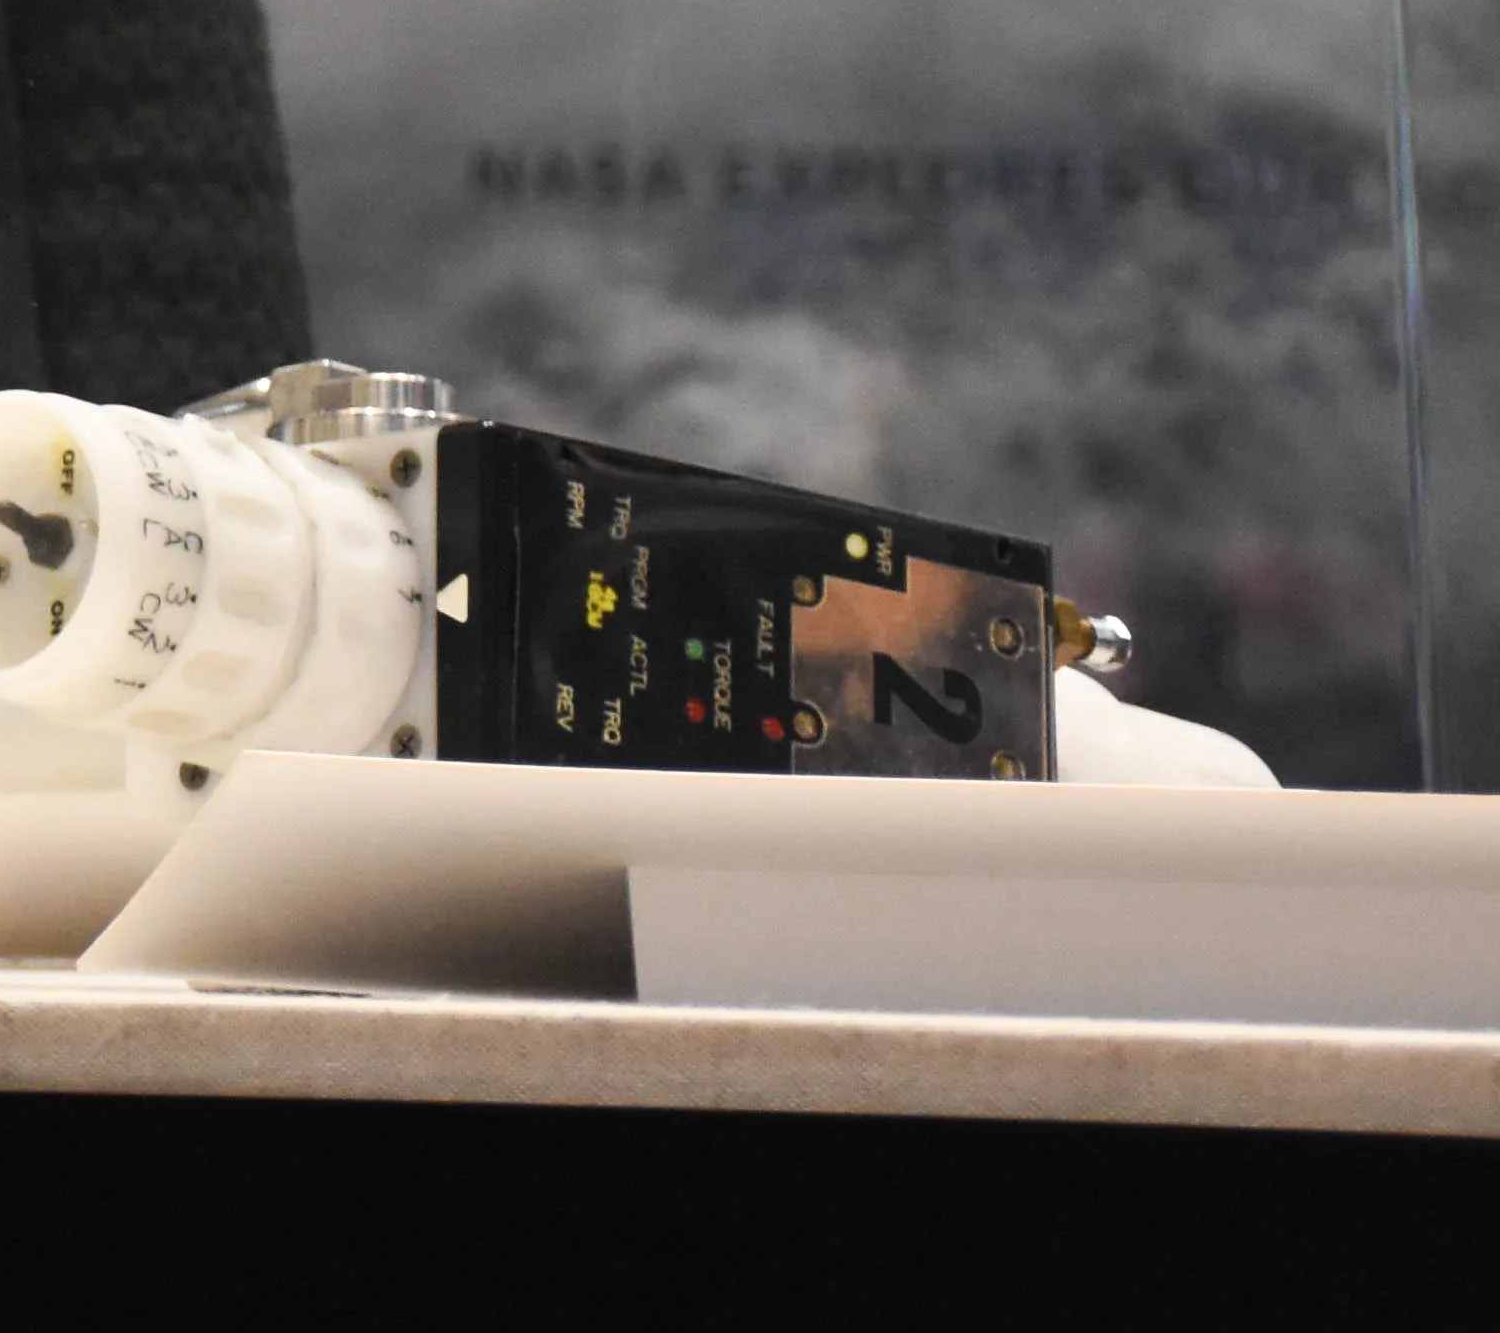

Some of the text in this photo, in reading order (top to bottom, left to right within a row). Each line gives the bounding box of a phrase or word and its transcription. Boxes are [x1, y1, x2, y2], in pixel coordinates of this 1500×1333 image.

[60, 449, 75, 496] OFF
[567, 481, 586, 530] RPM
[610, 494, 632, 539] TRQ
[876, 524, 894, 577] PWR
[630, 632, 648, 697] ACTL
[757, 598, 775, 679] FAULT
[556, 682, 575, 733] REV
[713, 638, 732, 733] TORQUE
[872, 651, 983, 746] 2
[602, 697, 621, 746] TRQ
